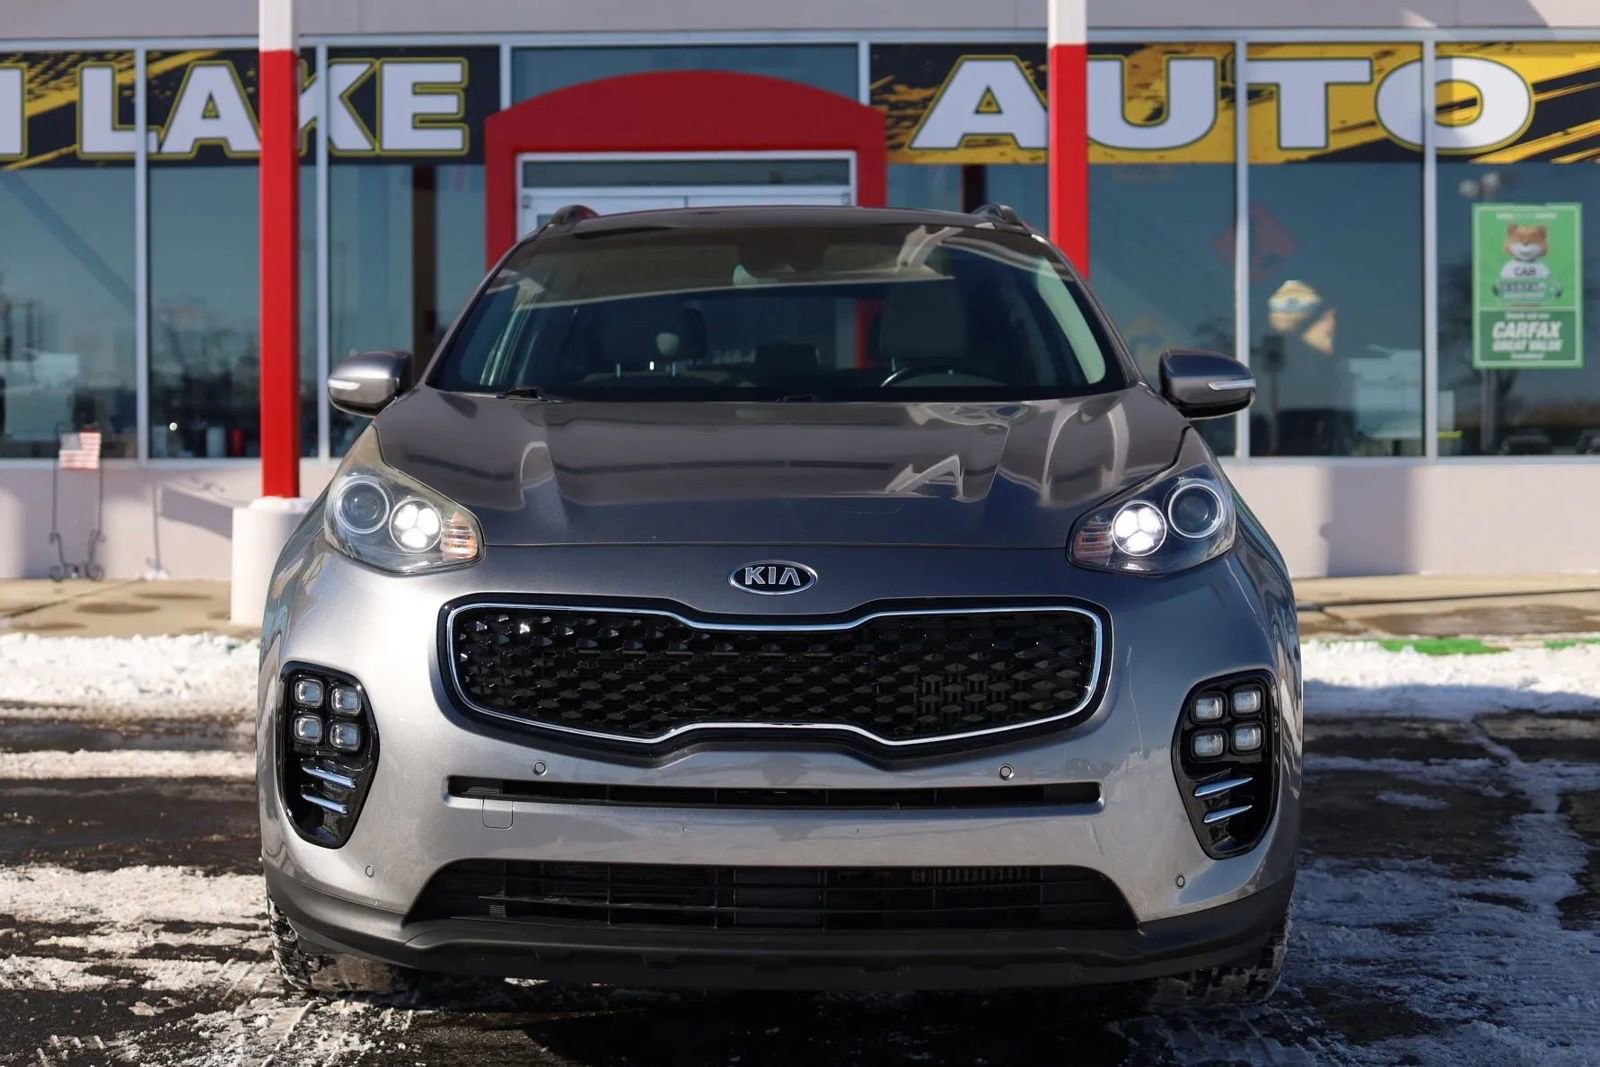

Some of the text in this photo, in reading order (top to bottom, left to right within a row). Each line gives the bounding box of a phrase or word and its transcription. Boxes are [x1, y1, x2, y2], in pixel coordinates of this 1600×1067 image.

[78, 58, 469, 158] LAKE
[908, 55, 1534, 154] AUTO
[1492, 321, 1562, 338] CARFAX
[745, 566, 801, 586] KIA
